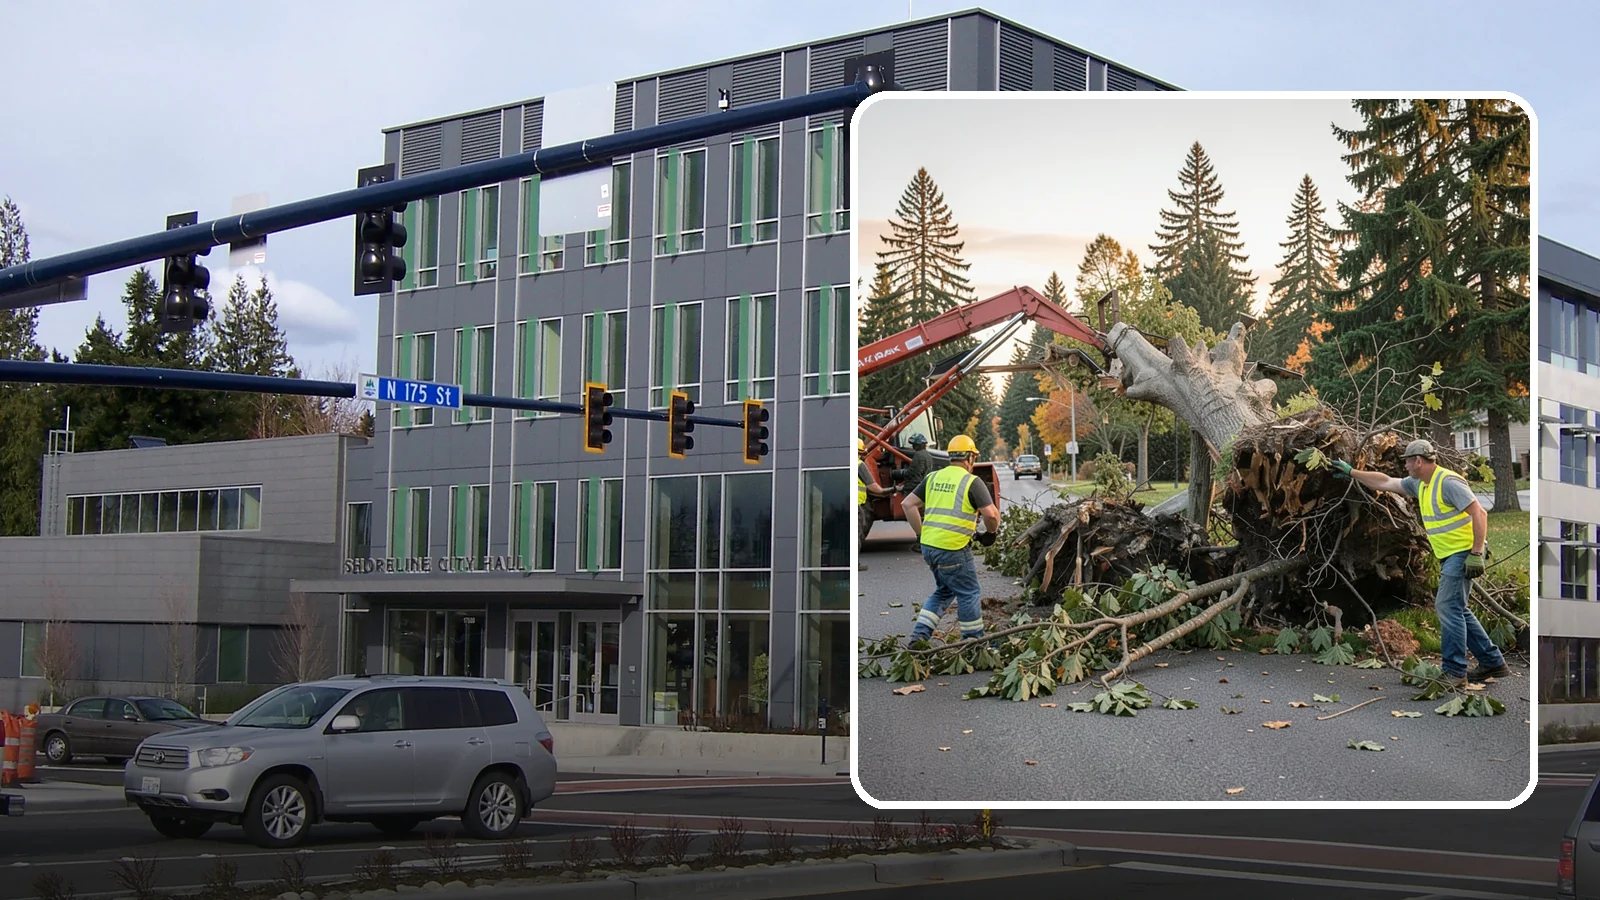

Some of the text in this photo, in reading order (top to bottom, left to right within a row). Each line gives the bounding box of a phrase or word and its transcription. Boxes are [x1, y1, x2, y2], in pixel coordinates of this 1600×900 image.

[387, 380, 451, 406] N 175 St
[345, 555, 526, 574] SHORELINE CITY HALL
